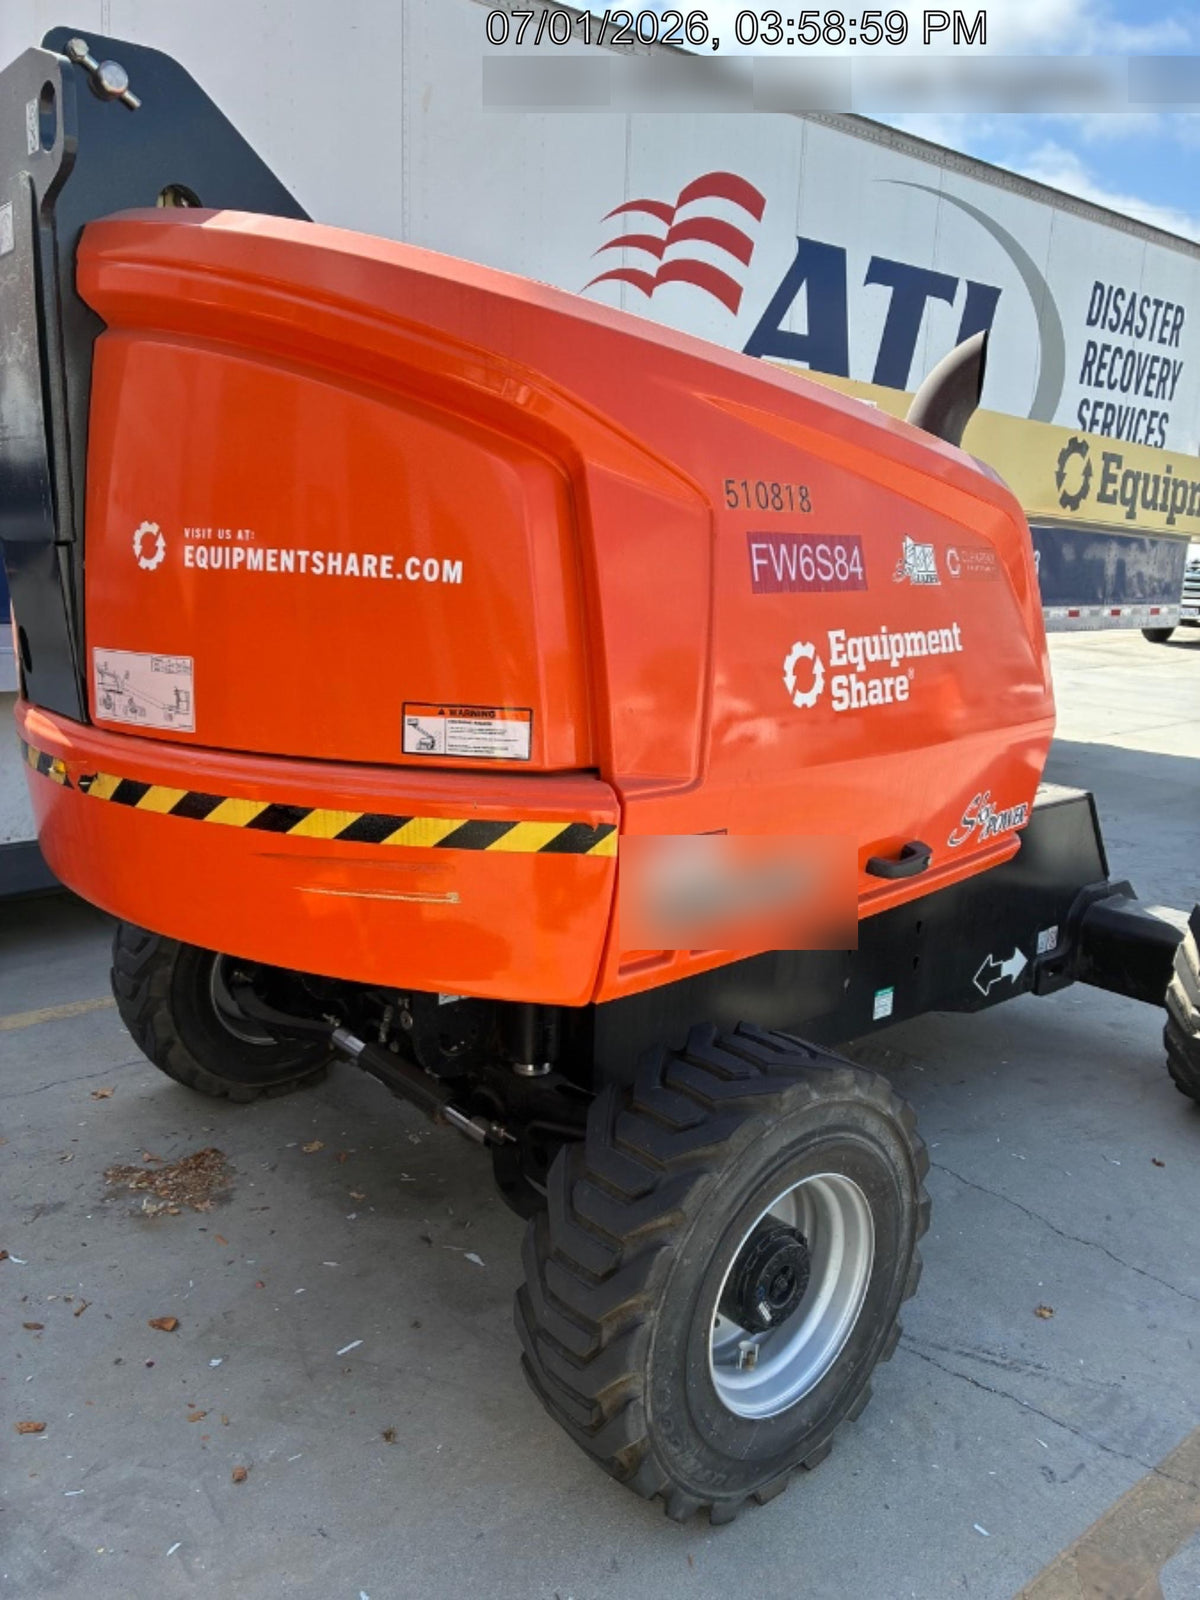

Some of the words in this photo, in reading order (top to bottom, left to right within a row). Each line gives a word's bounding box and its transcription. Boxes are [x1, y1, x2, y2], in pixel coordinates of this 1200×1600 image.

[1086, 281, 1184, 348] DISASTER
[1079, 339, 1183, 401] RECOVERY
[1077, 398, 1169, 449] SERVICES
[725, 479, 812, 513] 510818
[183, 527, 213, 540] VISIT
[218, 528, 232, 540] US
[237, 529, 255, 541] AT:
[184, 545, 463, 584] EQUIPMENTSHARE.COM
[751, 543, 863, 582] FW6S84
[828, 622, 963, 672] Equipment
